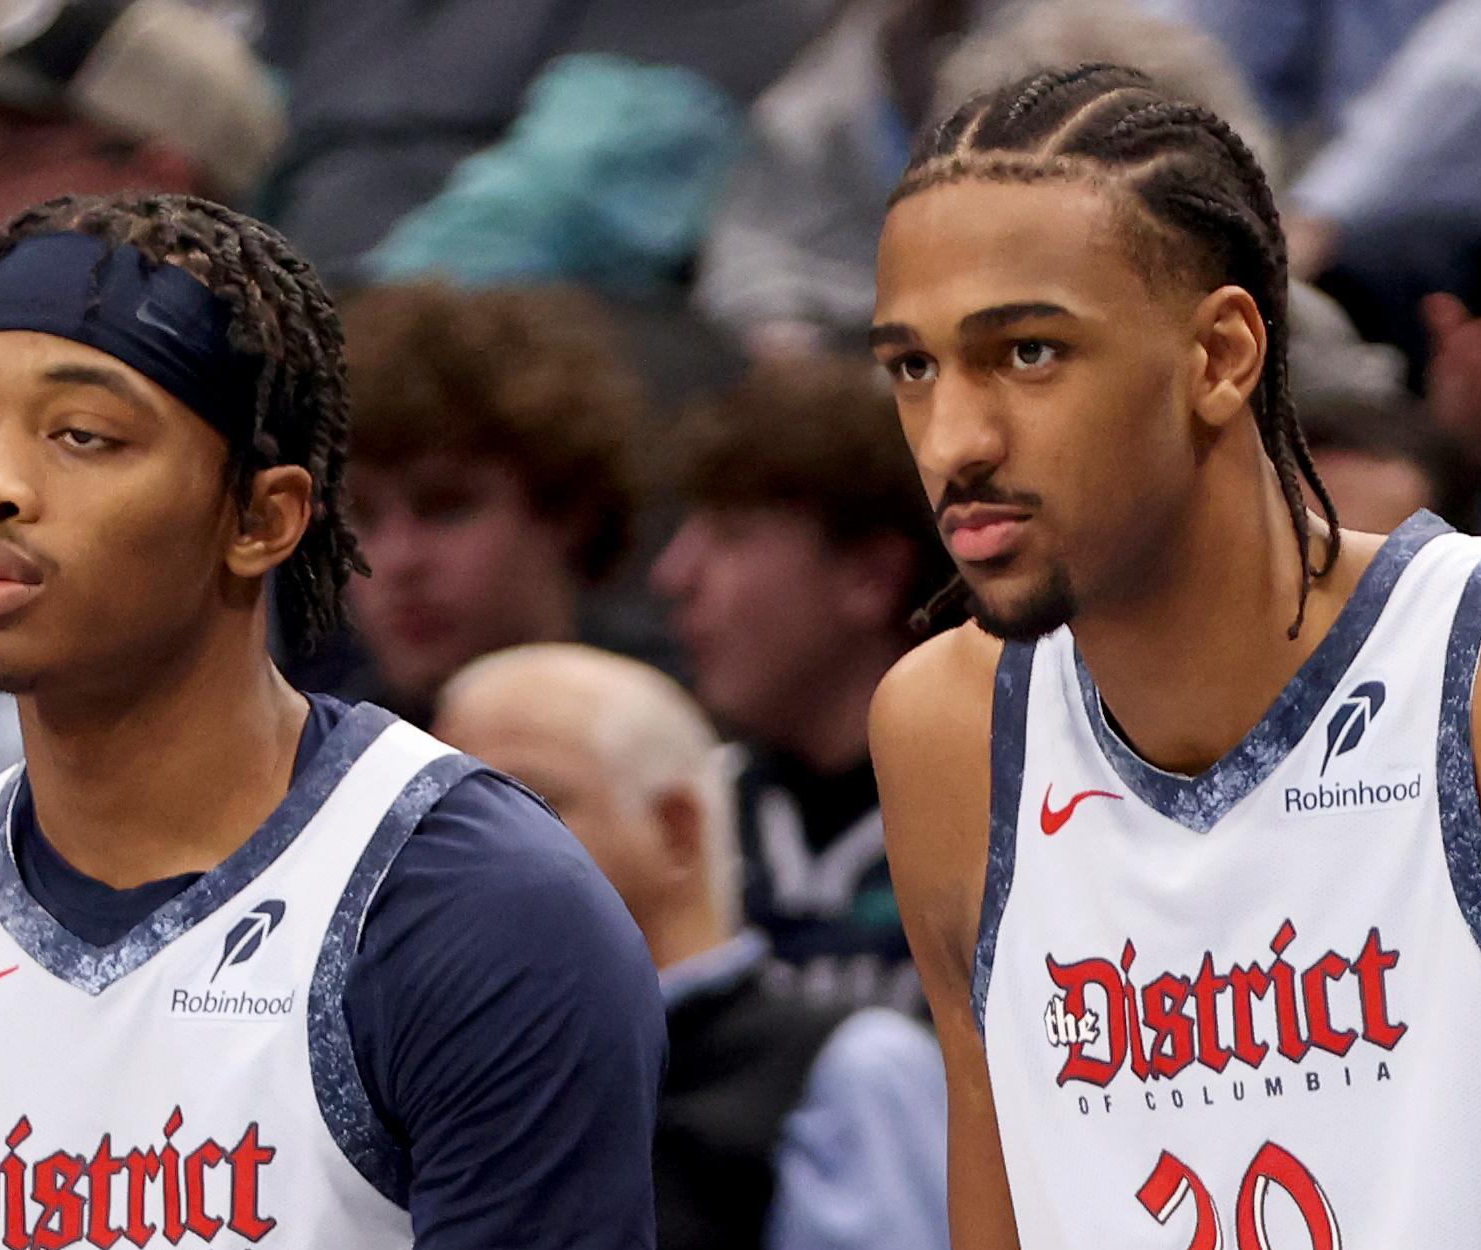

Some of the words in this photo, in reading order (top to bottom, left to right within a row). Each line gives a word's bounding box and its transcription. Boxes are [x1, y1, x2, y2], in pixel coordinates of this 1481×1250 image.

[1284, 774, 1421, 813] Robinhood
[171, 989, 293, 1016] Robinhood
[1044, 995, 1101, 1048] the
[1045, 918, 1409, 1089] District
[1078, 1095, 1113, 1115] OF
[1145, 1061, 1391, 1110] COLUMBIA
